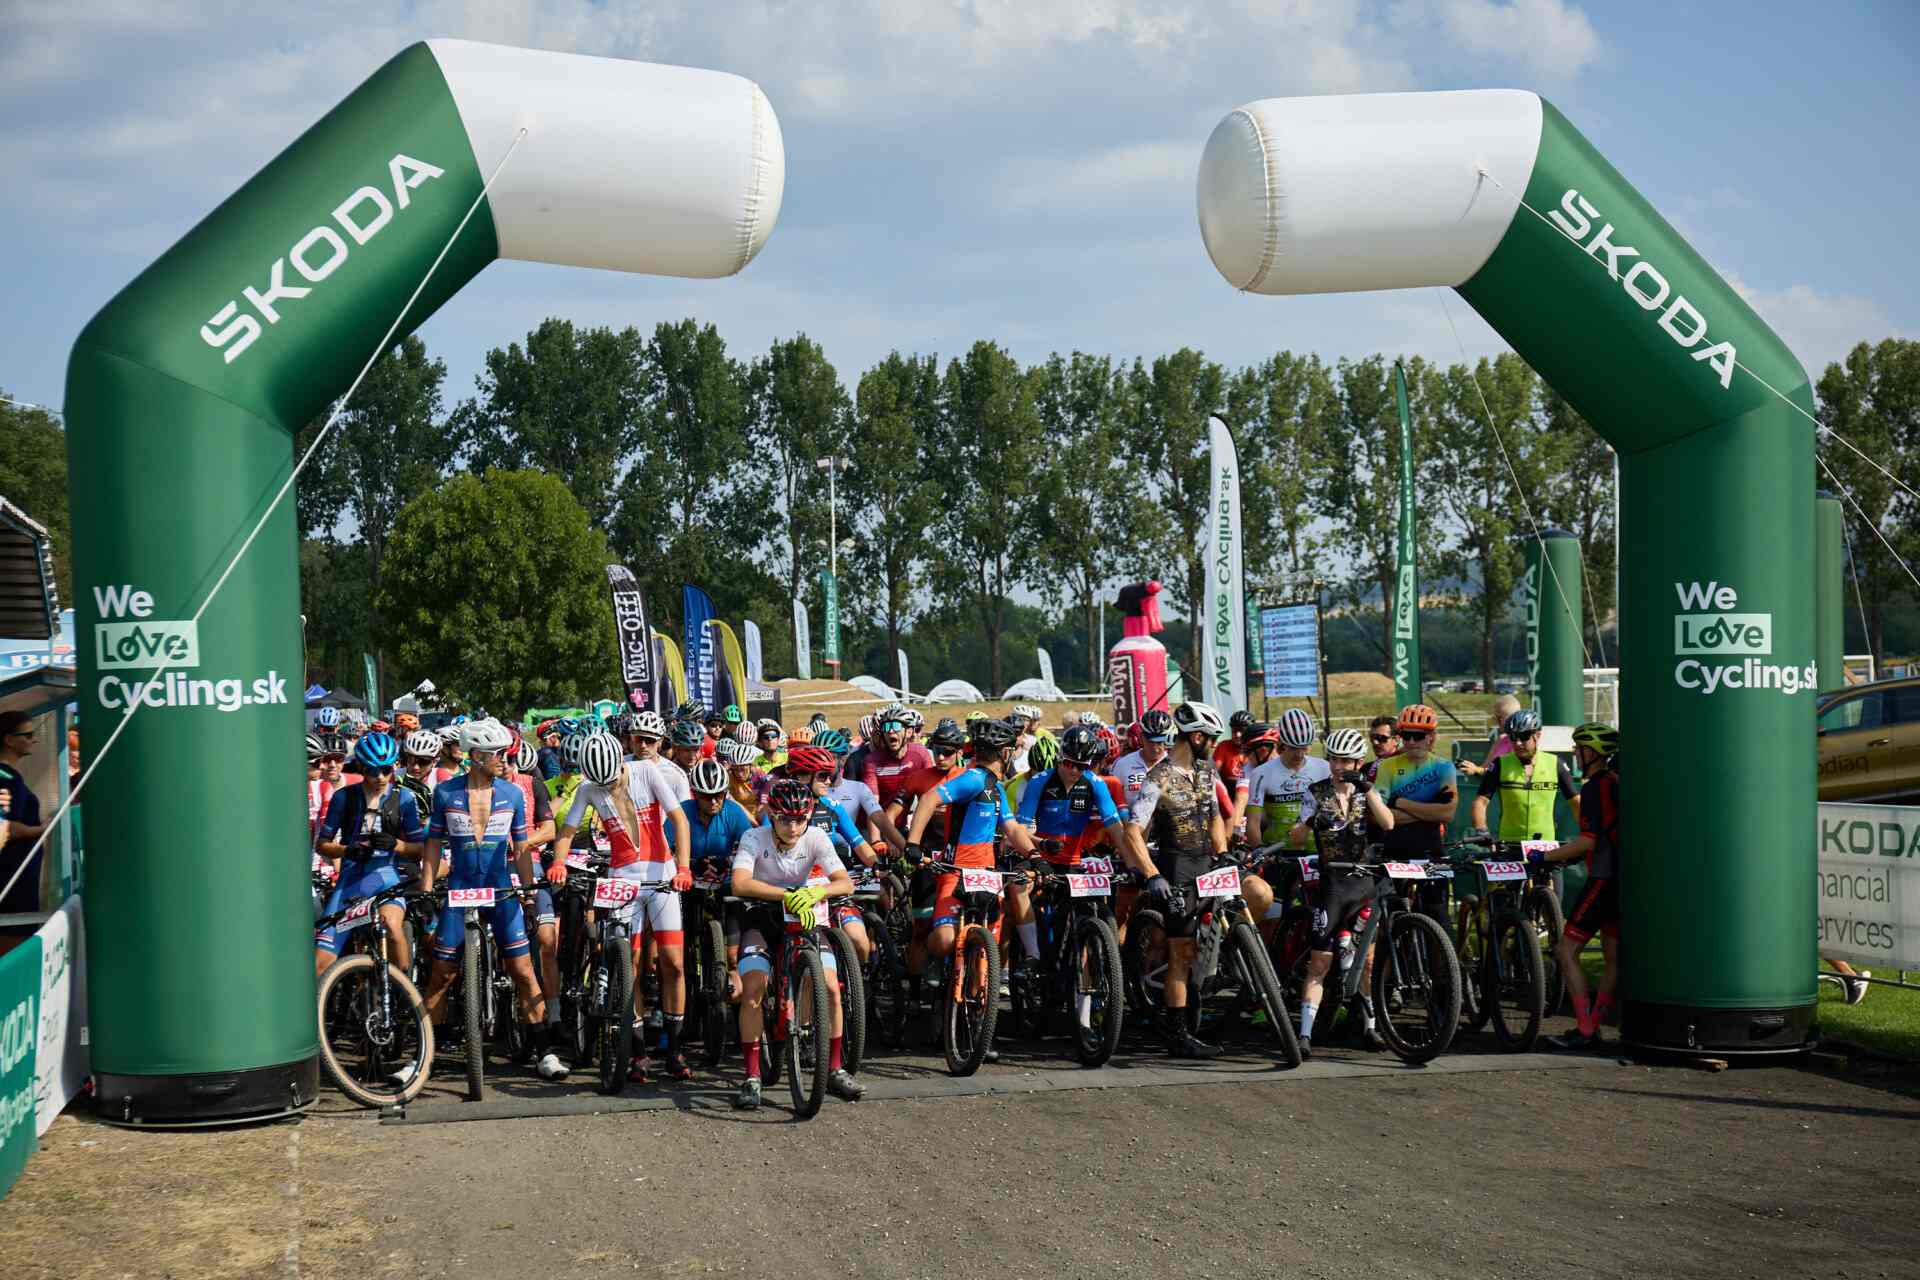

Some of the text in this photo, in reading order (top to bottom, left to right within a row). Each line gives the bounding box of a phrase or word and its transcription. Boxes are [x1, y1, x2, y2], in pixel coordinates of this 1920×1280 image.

[93, 584, 155, 618] We
[1675, 581, 1737, 610] We
[98, 670, 288, 714] Cycling.sk
[1674, 658, 1818, 694] Cycling.sk
[600, 883, 634, 901] 356
[1075, 876, 1105, 888] 210
[0, 994, 34, 1077] ODA
